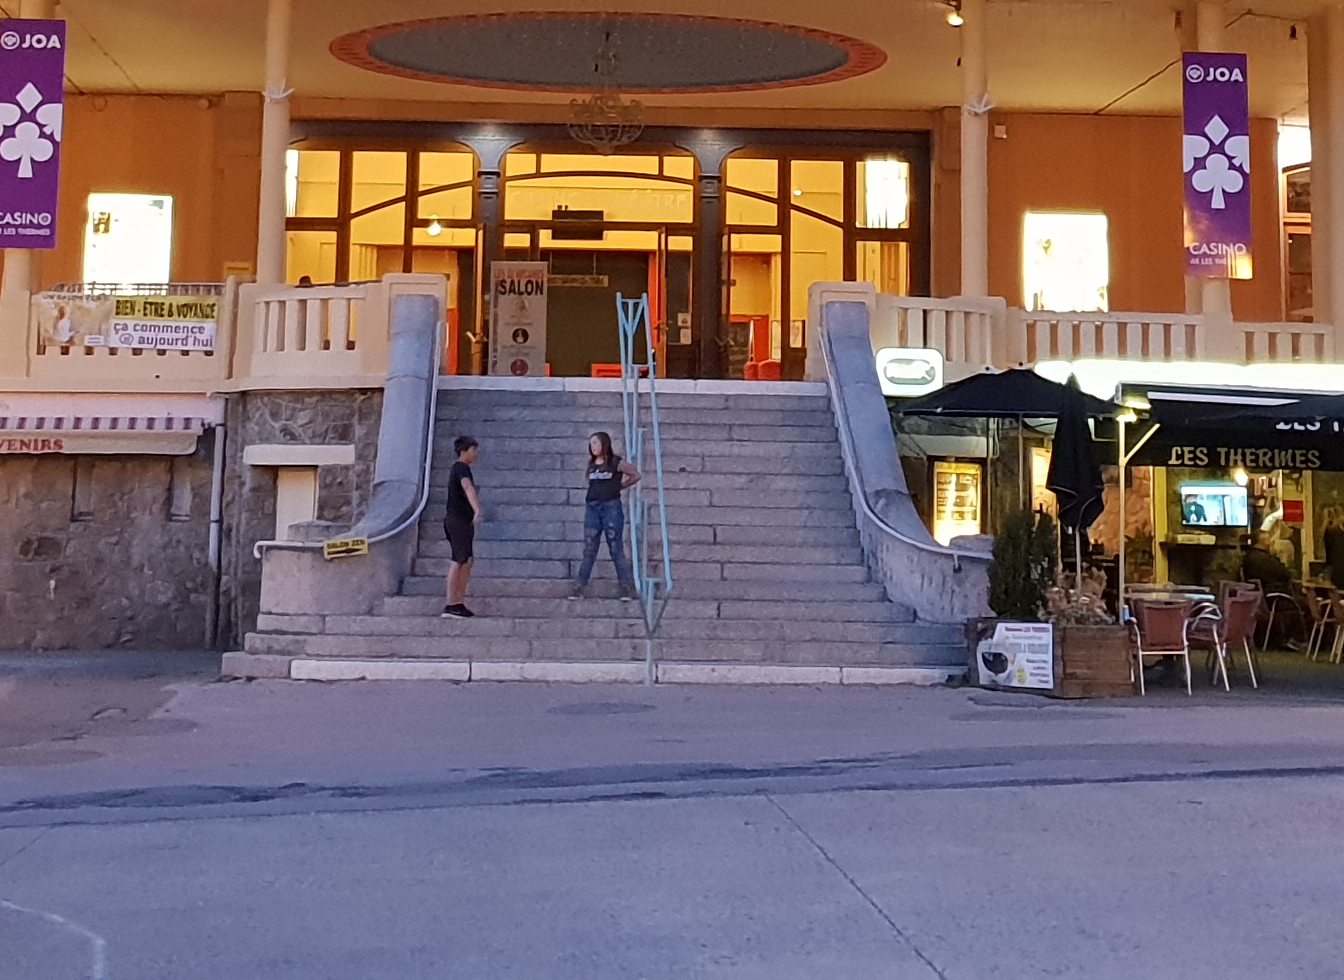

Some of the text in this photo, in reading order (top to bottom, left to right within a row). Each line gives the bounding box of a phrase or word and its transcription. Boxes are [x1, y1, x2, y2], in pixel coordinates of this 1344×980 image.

[22, 33, 61, 49] JOA
[1206, 67, 1244, 82] JOA
[1189, 242, 1247, 256] CASINO
[499, 278, 544, 296] SALON
[115, 299, 136, 317] BIEN
[177, 302, 217, 319] VOYANCE
[113, 323, 205, 335] ça commence
[138, 334, 214, 349] aujourd'hui
[1168, 446, 1321, 468] LES THERMES
